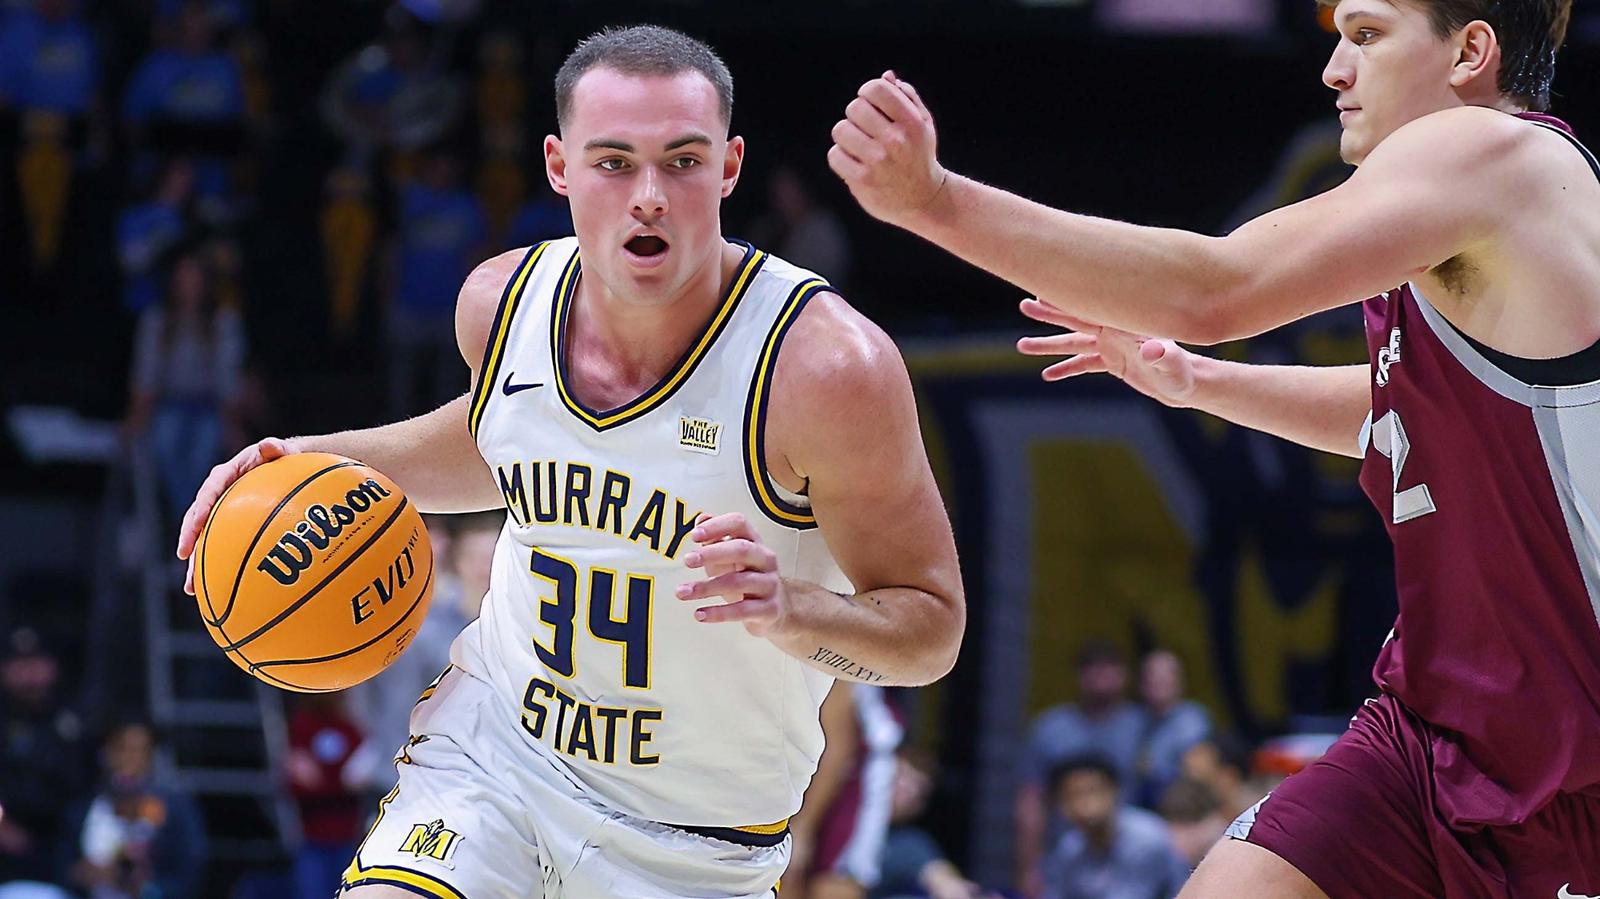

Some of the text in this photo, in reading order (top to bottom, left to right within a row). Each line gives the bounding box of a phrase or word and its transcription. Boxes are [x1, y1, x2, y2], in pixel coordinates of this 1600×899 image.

[681, 418, 719, 445] VALLEY
[257, 478, 391, 586] Wilson
[498, 460, 703, 560] MURRAY
[530, 545, 655, 690] 34
[520, 676, 664, 767] STATE
